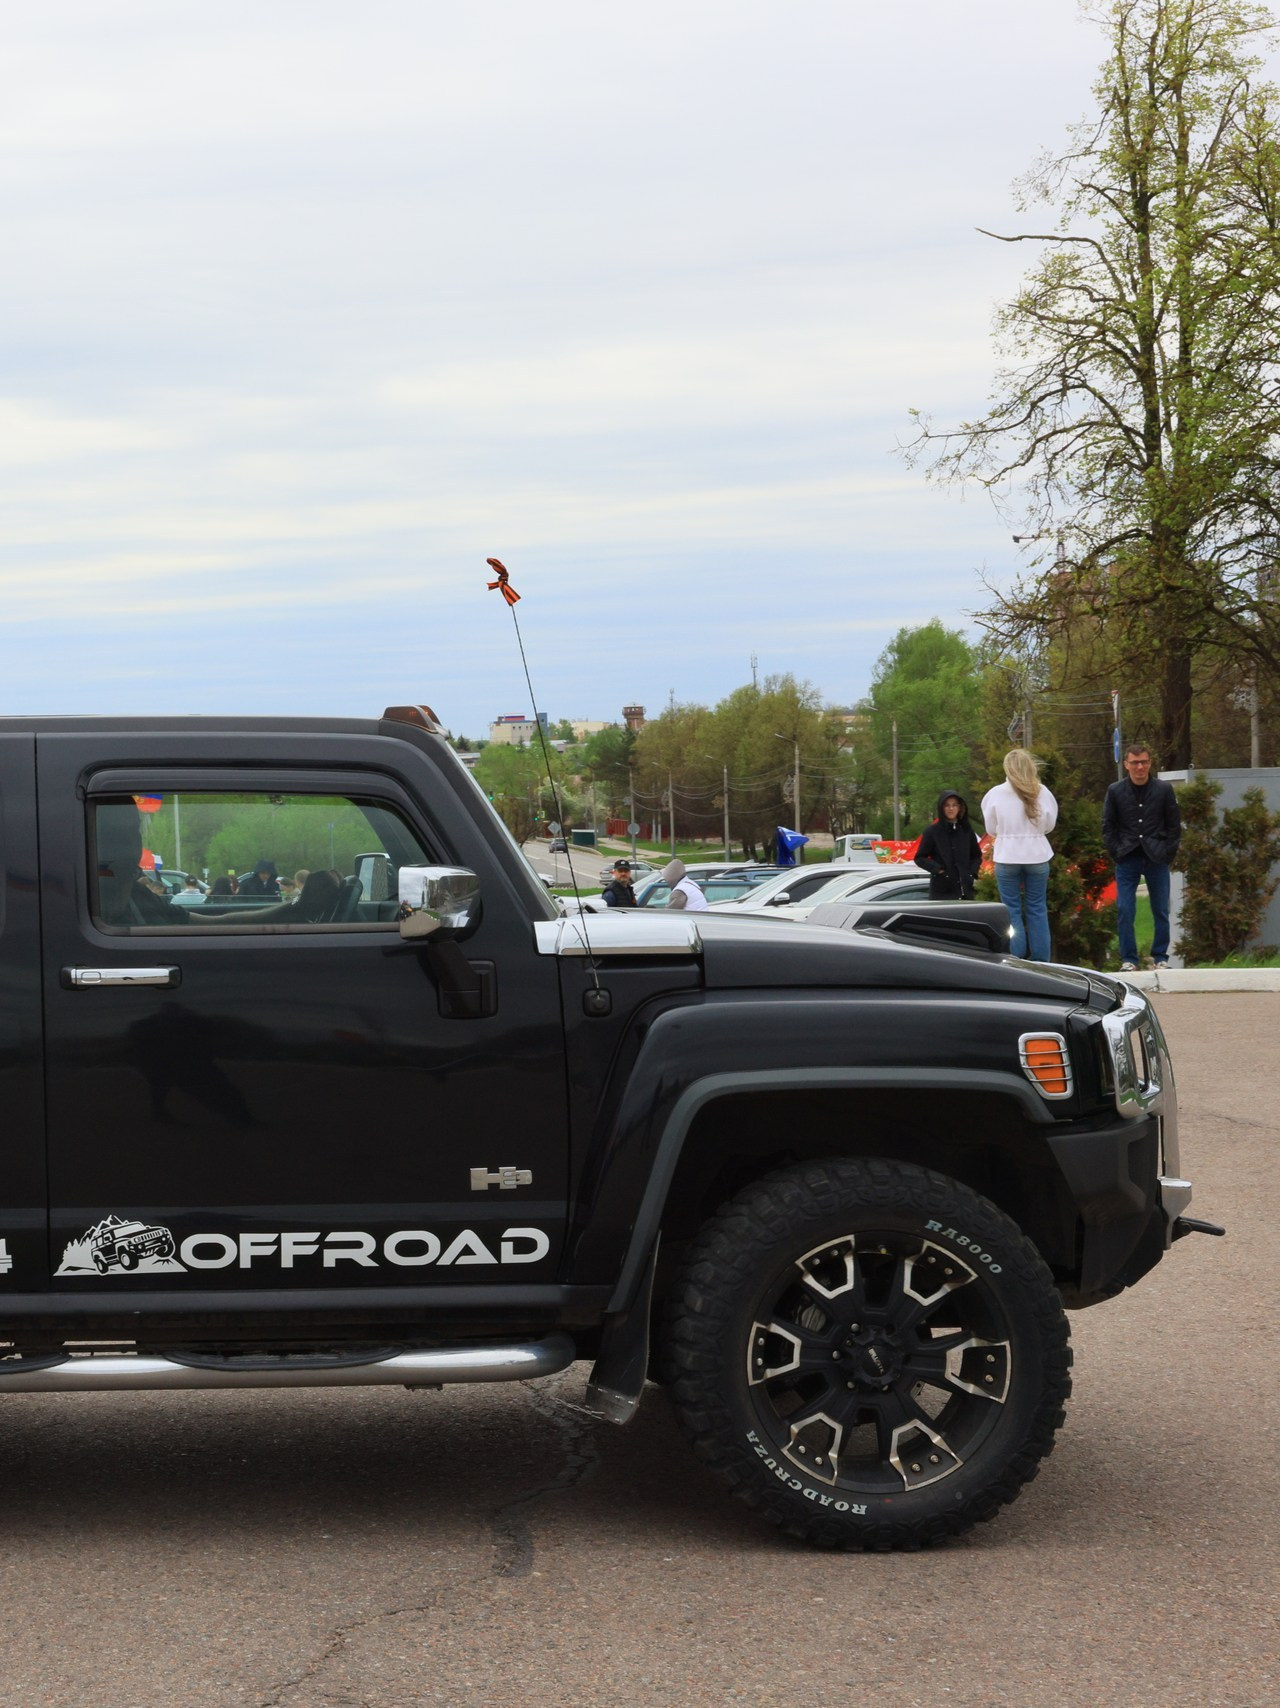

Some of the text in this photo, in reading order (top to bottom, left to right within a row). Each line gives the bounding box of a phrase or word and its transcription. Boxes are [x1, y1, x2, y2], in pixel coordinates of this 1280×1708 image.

[180, 1228, 550, 1270] OFFROAD
[924, 1219, 1002, 1274] RA8000
[746, 1430, 867, 1515] ROADCRUZA
